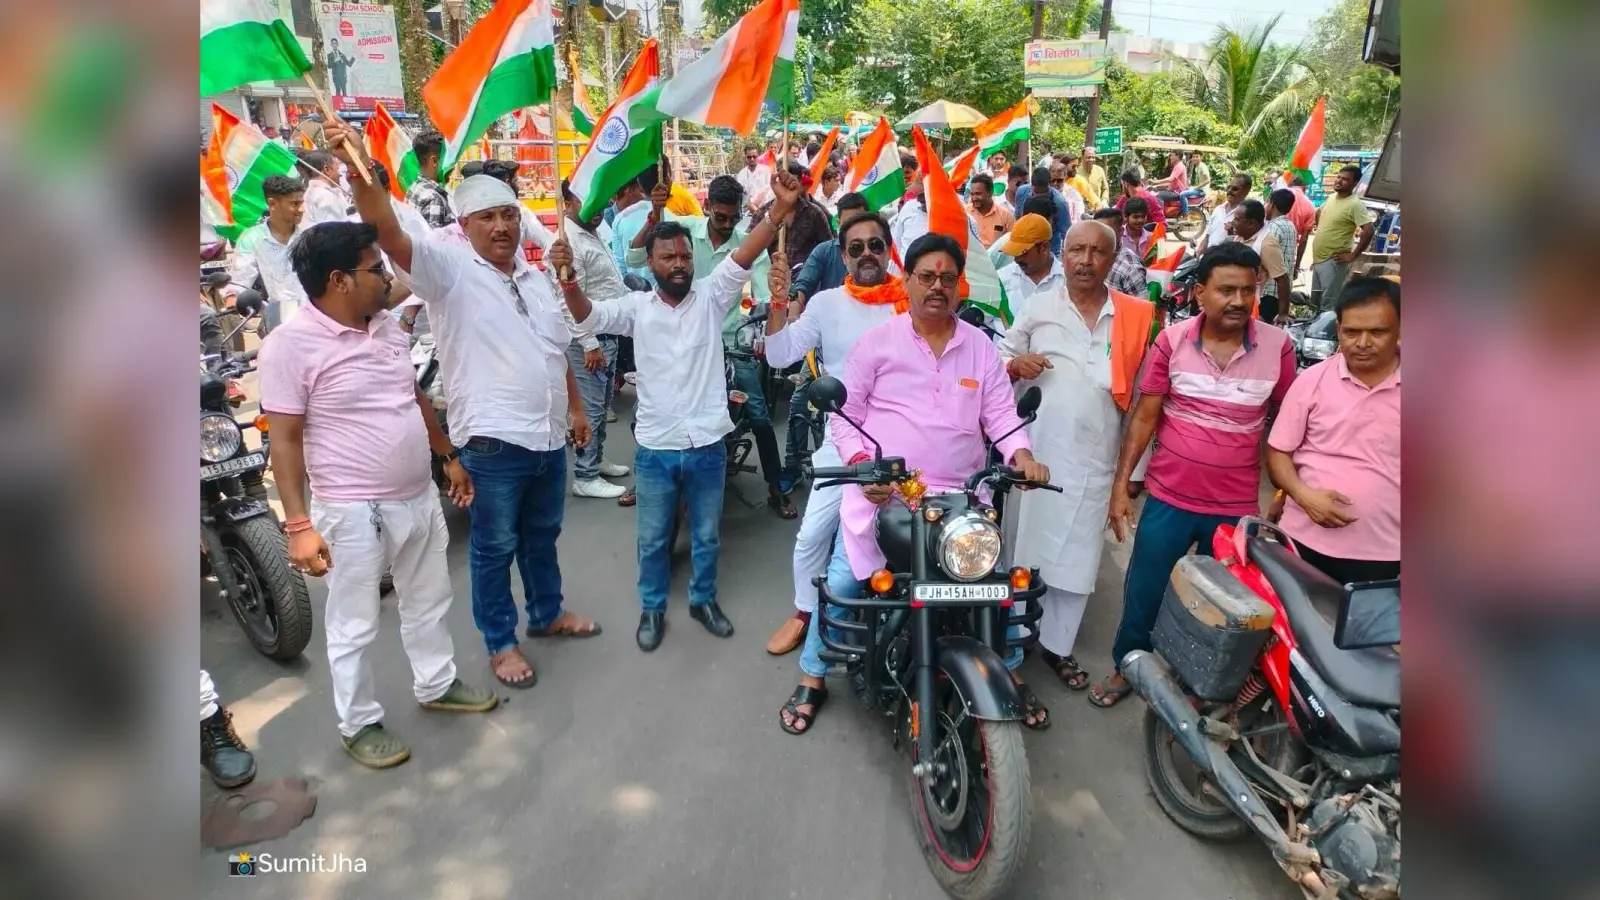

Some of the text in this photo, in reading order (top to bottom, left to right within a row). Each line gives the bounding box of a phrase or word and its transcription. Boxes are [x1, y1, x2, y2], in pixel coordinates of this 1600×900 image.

[332, 3, 386, 13] SHALOM SCHOOL
[358, 35, 393, 46] ADMISSION
[929, 586, 1006, 599] JH 15AH 1003
